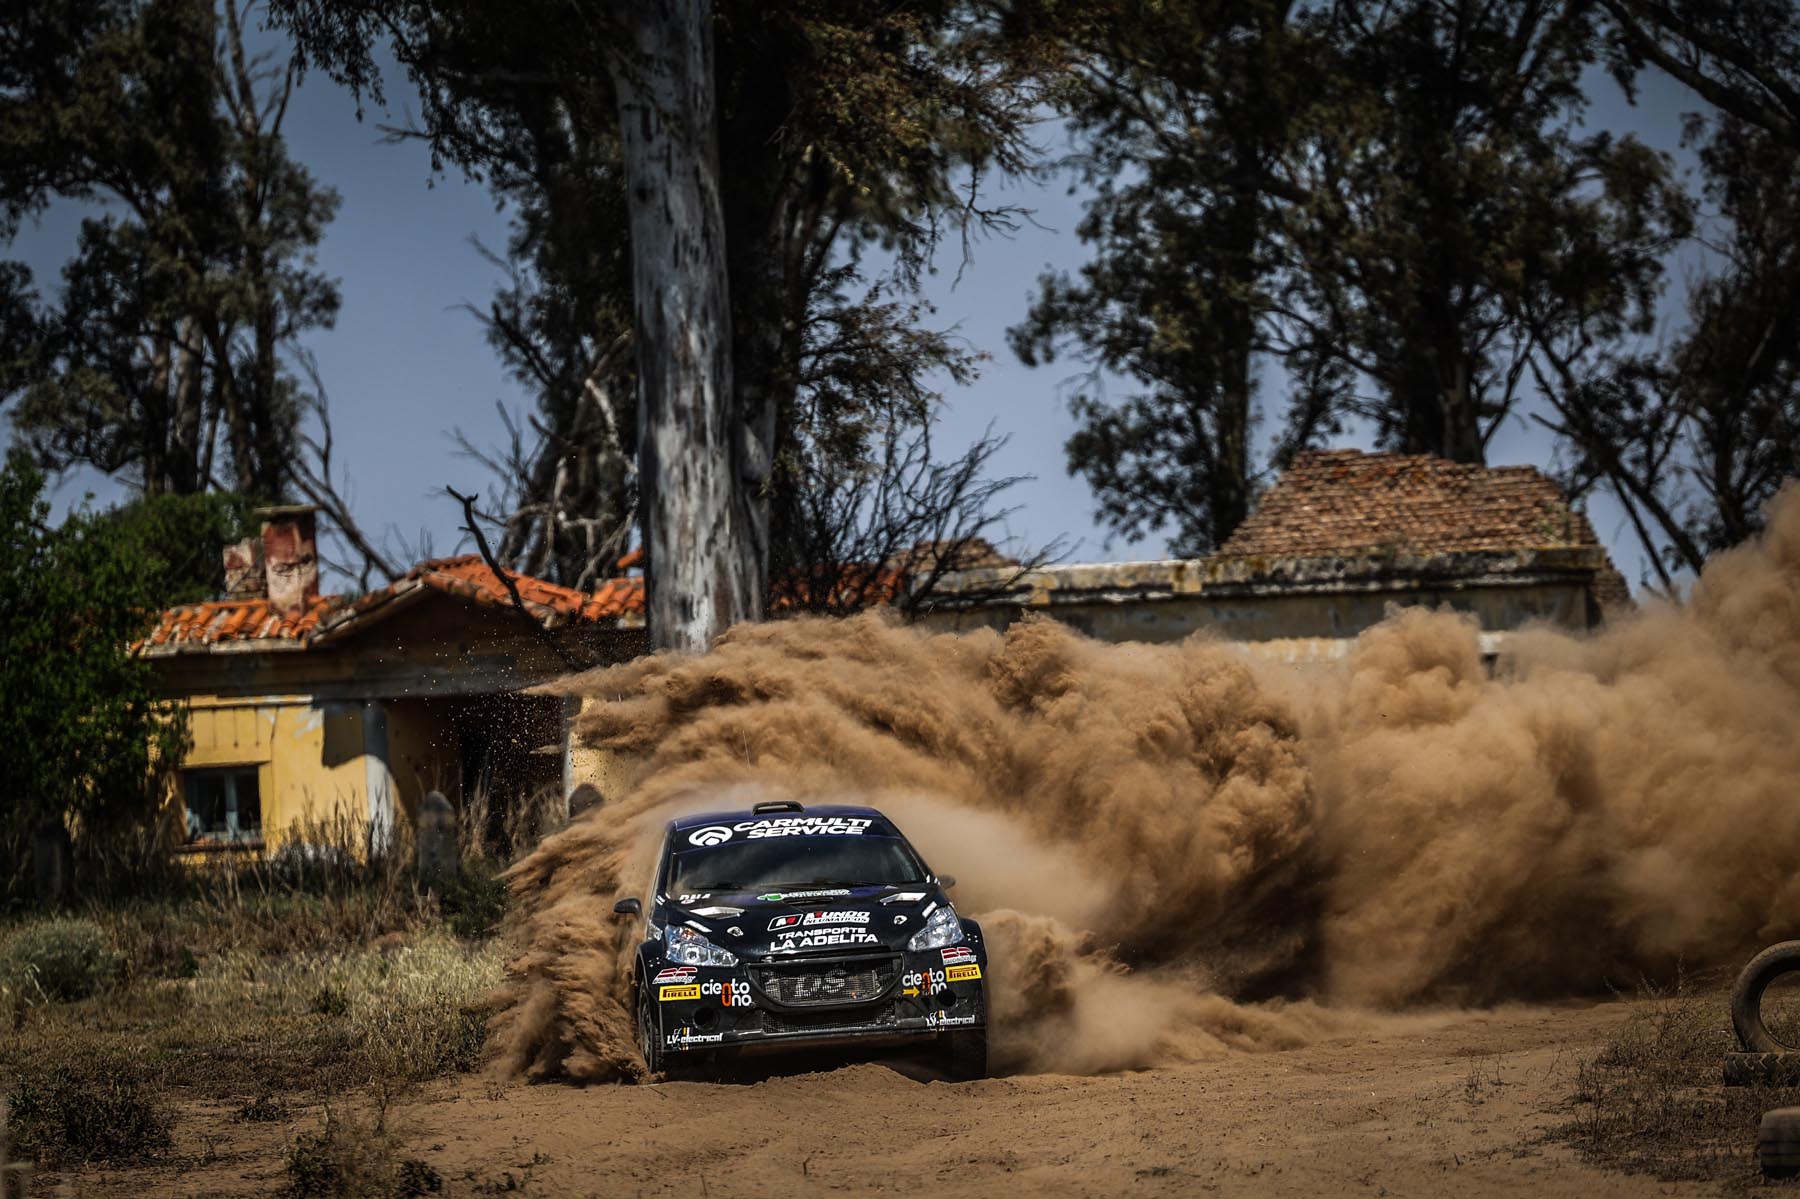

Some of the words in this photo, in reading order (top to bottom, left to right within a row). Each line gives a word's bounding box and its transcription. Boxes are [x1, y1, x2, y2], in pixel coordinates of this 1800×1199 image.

[733, 817, 872, 832] CARMULTI
[747, 825, 865, 839] SERVICE
[777, 927, 866, 940] TRANSPORTE
[770, 939, 795, 951] LA
[799, 934, 879, 947] ADELITA
[902, 967, 945, 987] ciento
[949, 966, 978, 979] PIRELLI
[662, 986, 697, 998] PIRELLI
[701, 978, 750, 995] ciento
